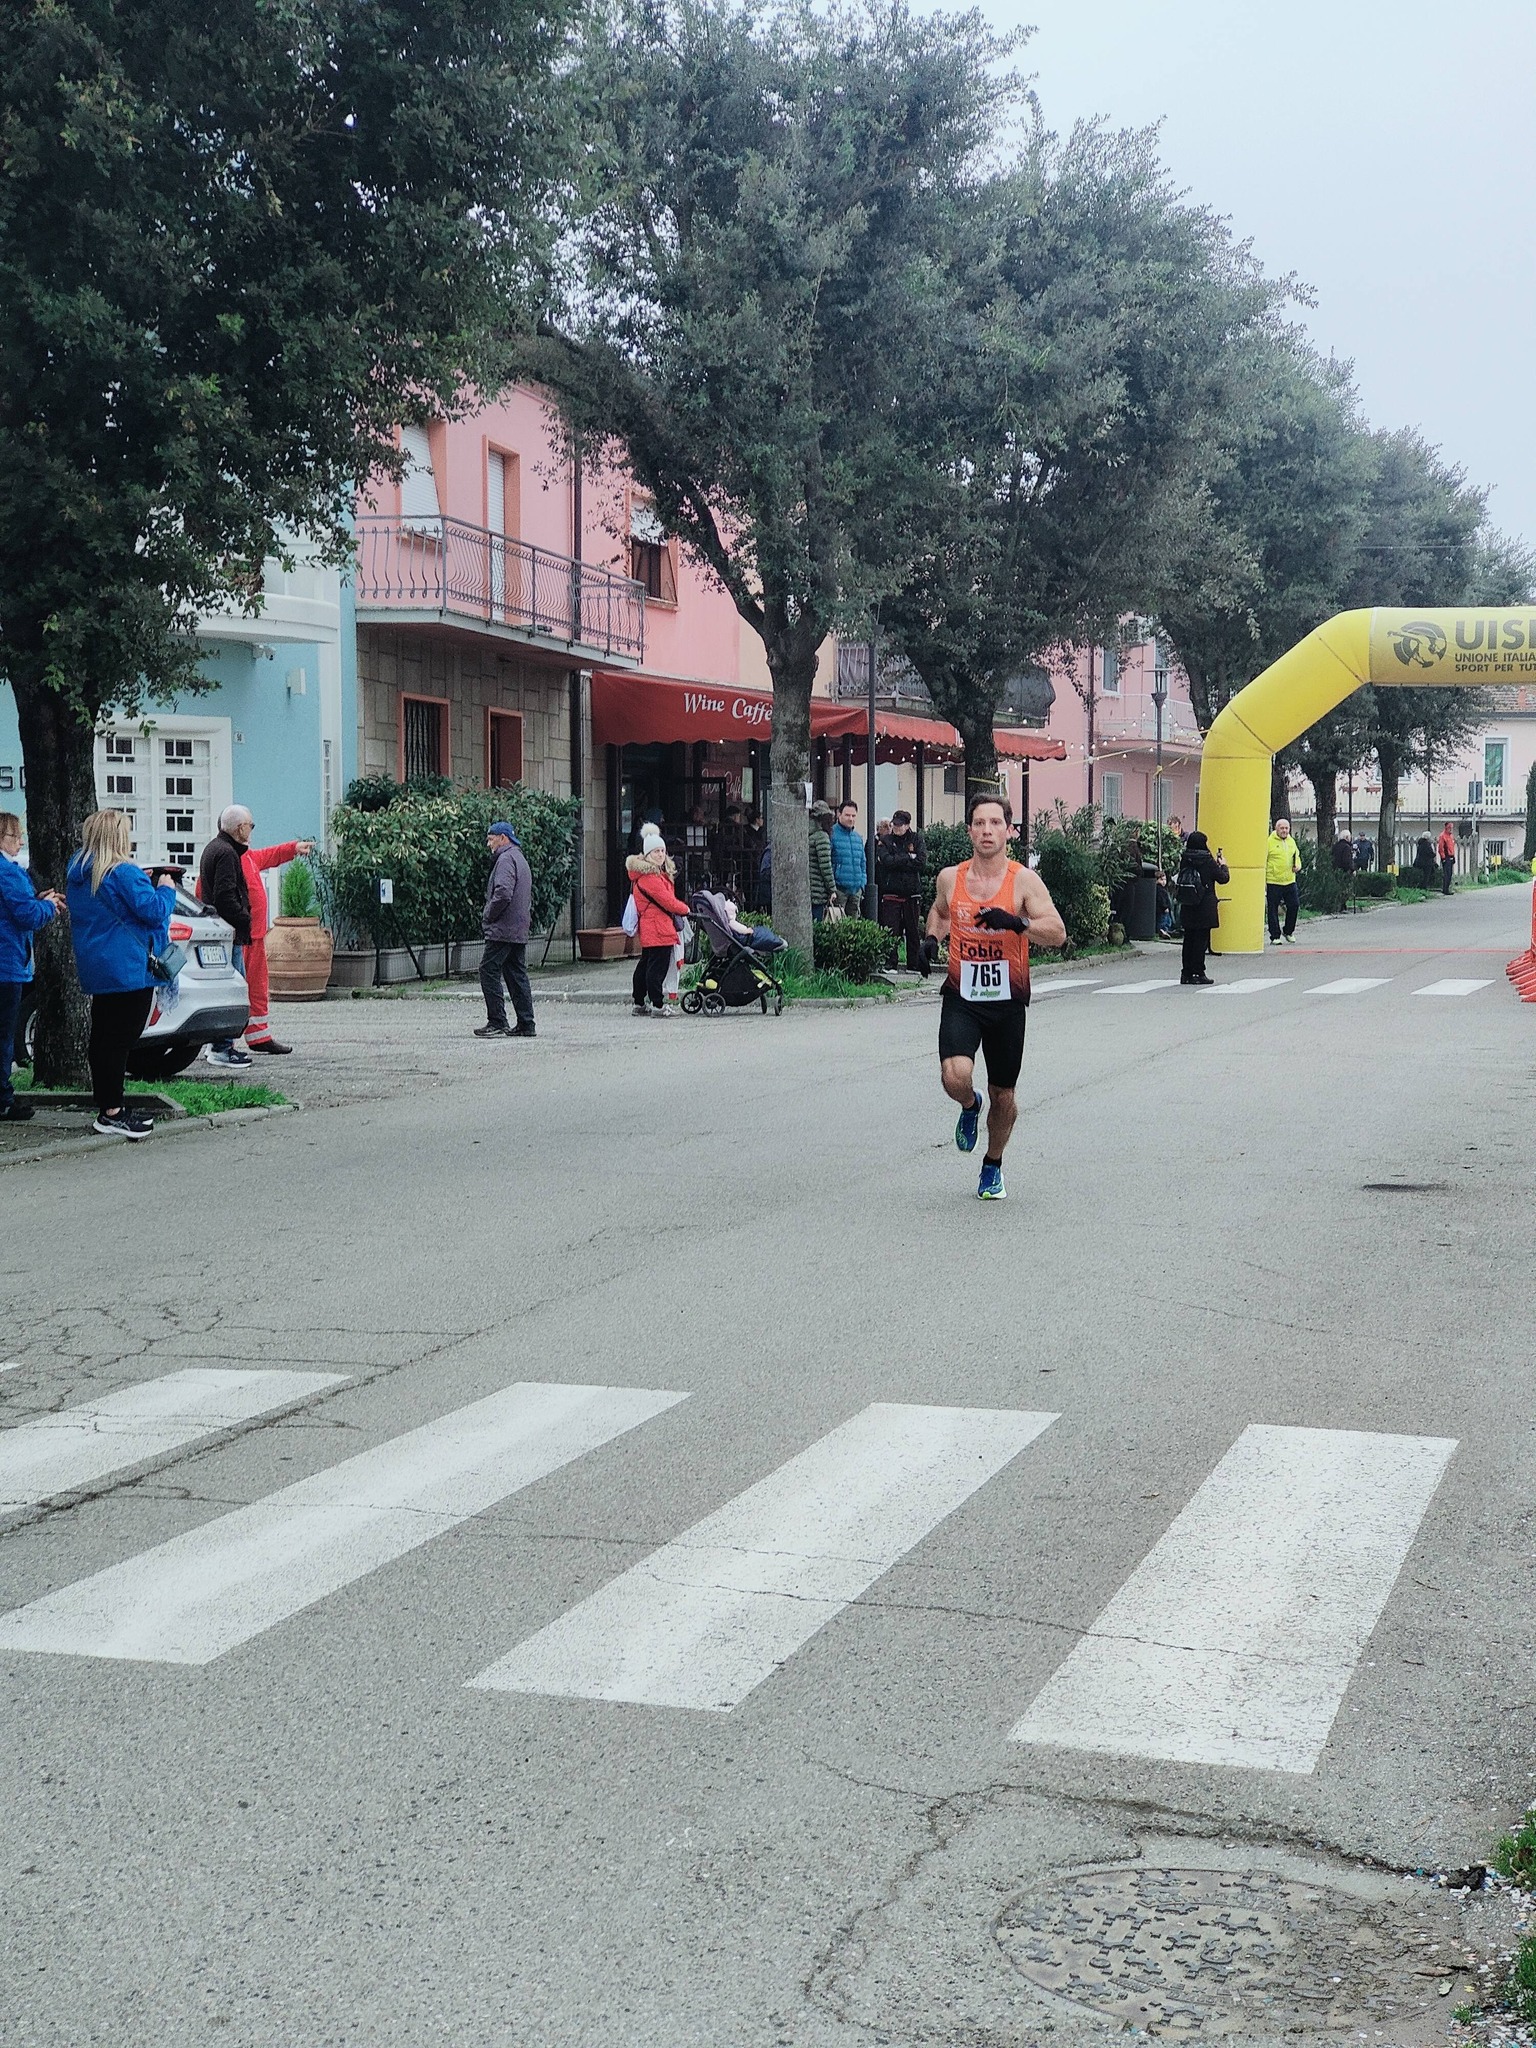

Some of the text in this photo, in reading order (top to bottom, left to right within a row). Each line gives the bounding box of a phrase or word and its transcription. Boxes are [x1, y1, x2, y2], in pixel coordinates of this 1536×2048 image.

[1455, 652, 1498, 662] UNIONE
[1455, 664, 1489, 672] SPORT
[1495, 663, 1513, 672] PER
[683, 692, 773, 725] Wine Caffè
[970, 962, 1001, 987] 765
